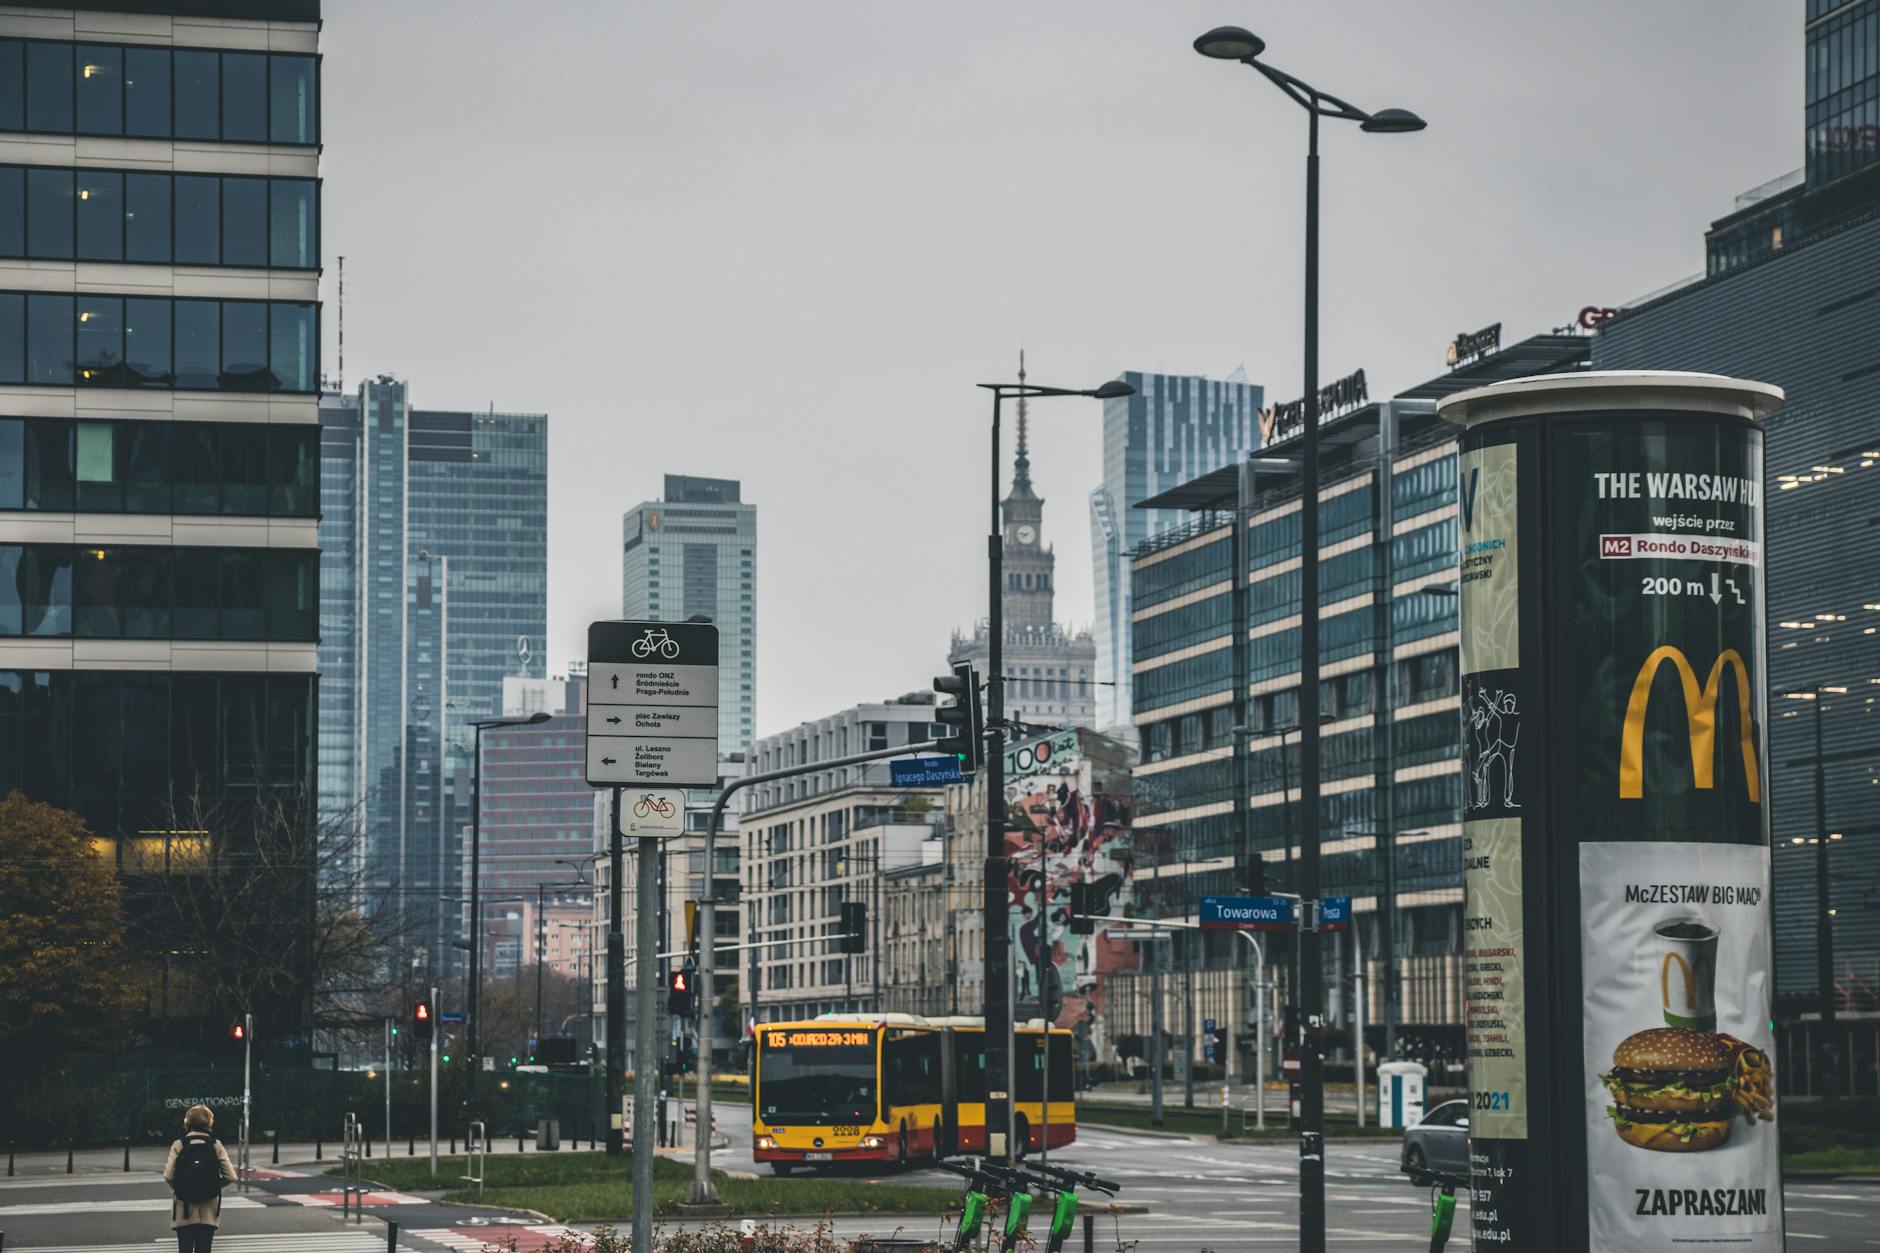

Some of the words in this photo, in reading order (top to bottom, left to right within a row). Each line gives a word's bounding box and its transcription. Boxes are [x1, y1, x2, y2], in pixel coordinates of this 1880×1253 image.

[1594, 473, 1641, 498] THE
[1647, 473, 1738, 502] WARSAW
[1740, 478, 1758, 507] HU
[1653, 514, 1703, 530] wejście
[1706, 519, 1735, 532] przez
[1604, 541, 1629, 553] M2
[1637, 540, 1686, 554] Rondo
[1641, 577, 1682, 595] 200
[1687, 582, 1704, 595] m
[636, 679, 680, 687] Śródmieście
[636, 688, 690, 696] Praga-Południe
[652, 713, 680, 721] Zawiszy
[1625, 885, 1709, 903] McZESTAW
[1712, 886, 1734, 904] BIG
[1216, 905, 1278, 919] Towarowa
[768, 1032, 787, 1047] 105
[1476, 1092, 1510, 1110] 2021
